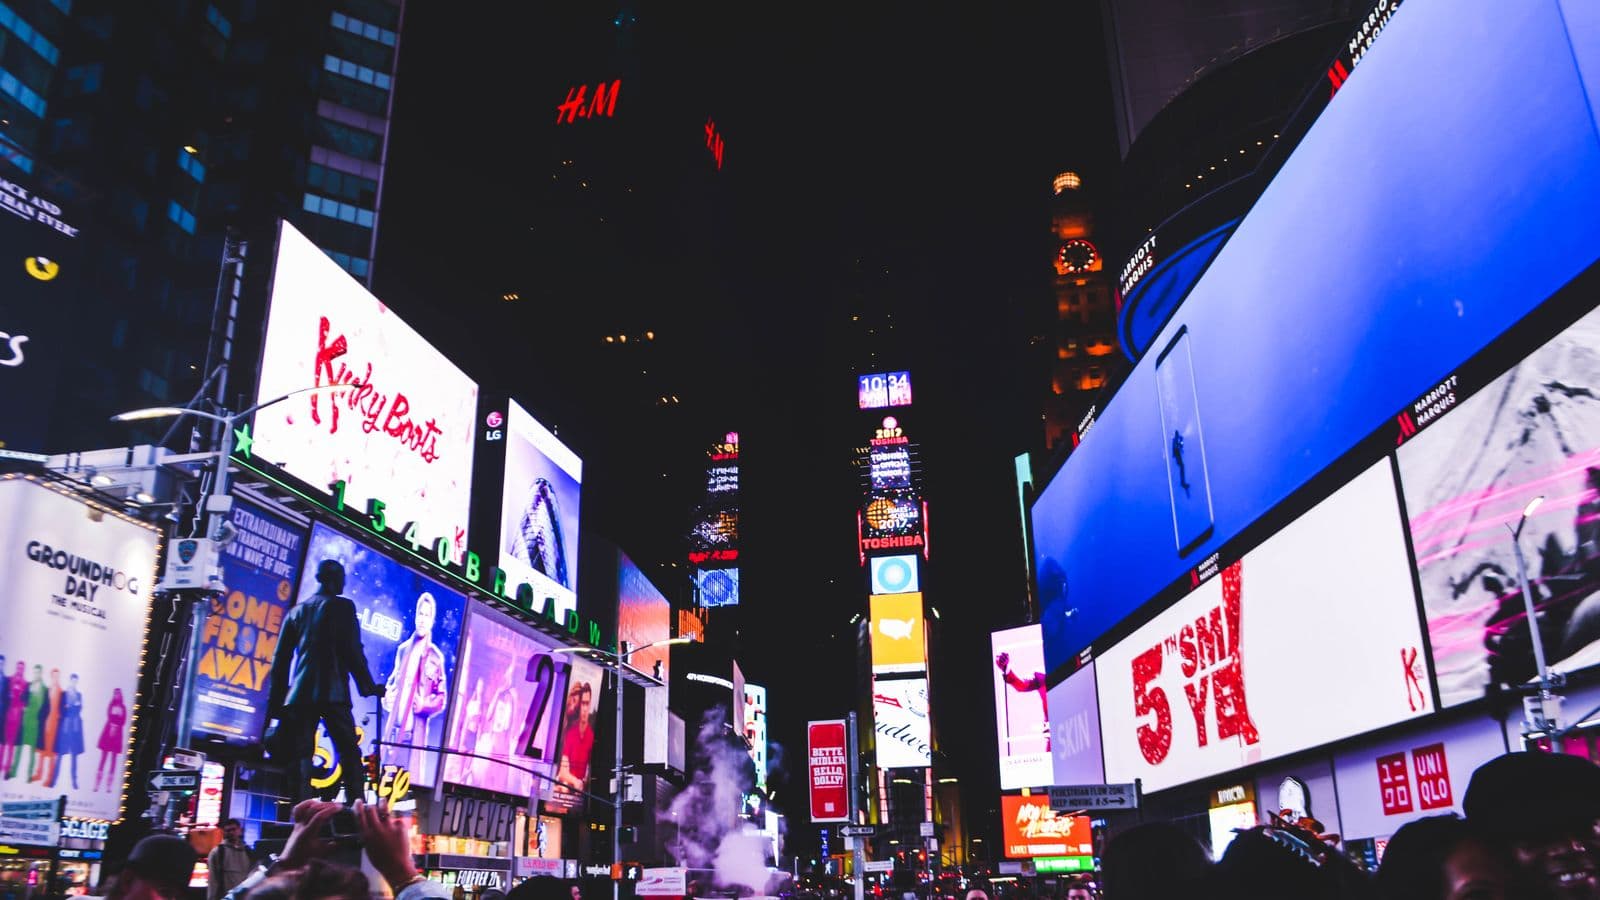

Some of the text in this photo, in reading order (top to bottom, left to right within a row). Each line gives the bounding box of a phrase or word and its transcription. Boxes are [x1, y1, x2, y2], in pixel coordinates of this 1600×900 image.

[557, 79, 621, 125] H&M
[31, 196, 62, 216] AND
[1119, 235, 1156, 285] MARRIOTT
[1122, 255, 1153, 299] MARQUIS
[861, 374, 908, 393] 10:34
[1414, 375, 1457, 413] MARRIOTT
[1417, 392, 1456, 426] MARQUIS
[486, 431, 502, 440] LG
[870, 436, 908, 446] TOSHIBA
[876, 428, 903, 439] 2017
[879, 518, 908, 530] 2017
[862, 534, 923, 550] TOSHIBA
[26, 540, 139, 595] GROUNDHOG
[65, 575, 98, 602] DAY
[52, 594, 106, 619] THE MUSICAL
[203, 615, 279, 661] FROM
[198, 647, 273, 692] AWAY
[514, 653, 572, 764] 21
[1055, 707, 1090, 760] SKIN
[811, 756, 845, 766] MIDLER
[812, 747, 843, 757] BETTE
[1416, 752, 1443, 776] UNI
[162, 776, 195, 785] ONE WAY
[814, 776, 844, 786] DOLLY!
[1051, 788, 1089, 798] PEDESTRIAN
[1420, 778, 1448, 805] QLO
[440, 795, 514, 841] FOREVER
